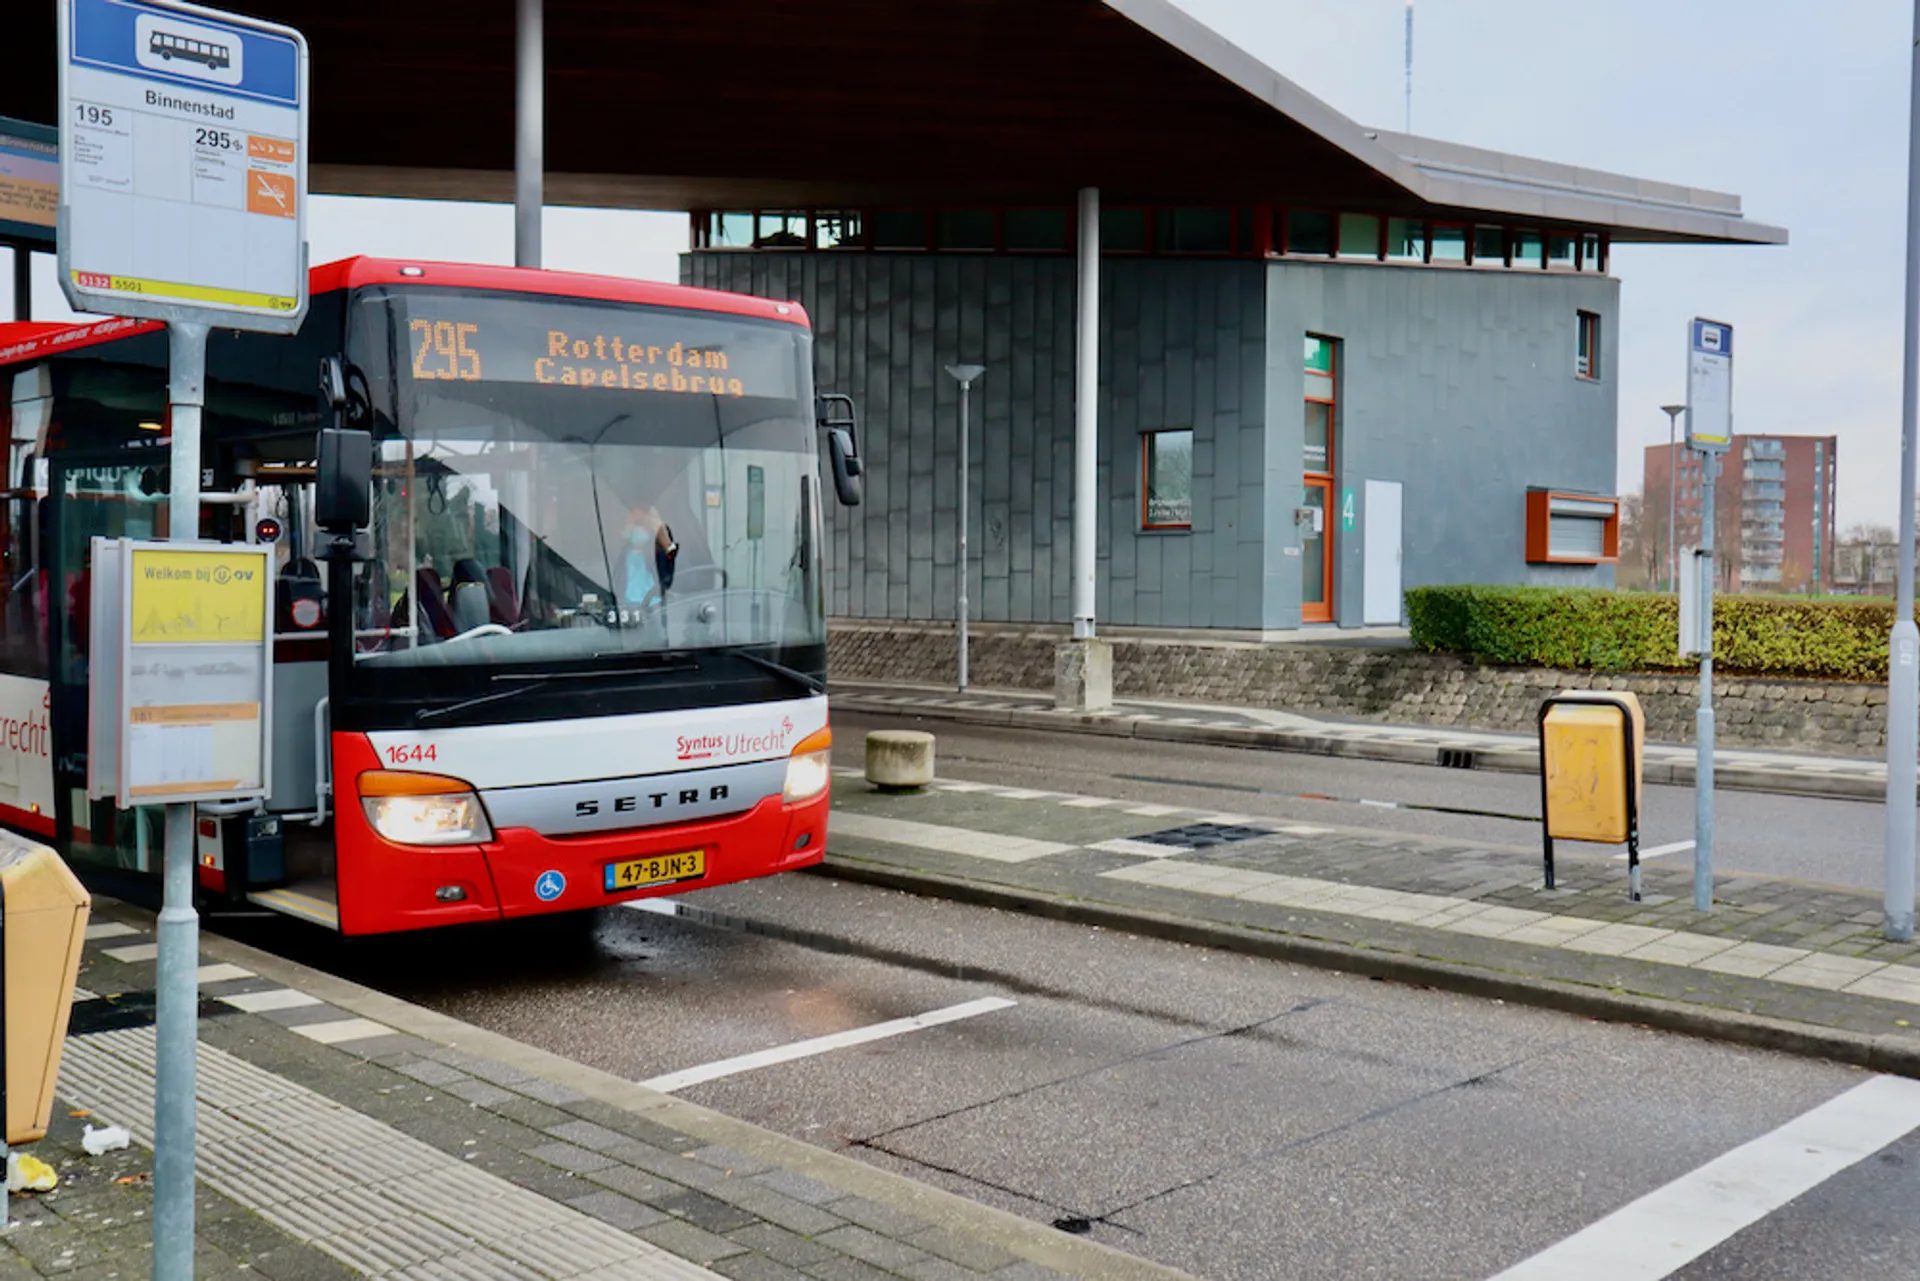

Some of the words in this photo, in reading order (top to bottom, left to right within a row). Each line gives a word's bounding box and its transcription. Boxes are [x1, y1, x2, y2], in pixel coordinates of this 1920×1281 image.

[76, 104, 113, 126] 195
[145, 89, 235, 120] Binnenstad
[195, 127, 231, 150] 295
[410, 319, 481, 381] 295
[547, 330, 729, 370] Rotterdam
[534, 357, 744, 397] Capelsebrug
[1342, 493, 1355, 527] 4
[144, 564, 192, 580] Welkom
[195, 566, 211, 583] bij
[385, 743, 437, 764] 1644
[676, 734, 723, 755] Syntus
[725, 729, 785, 756] Utrecht
[576, 785, 729, 817] SETRA
[622, 855, 697, 882] 47-BJN-3
